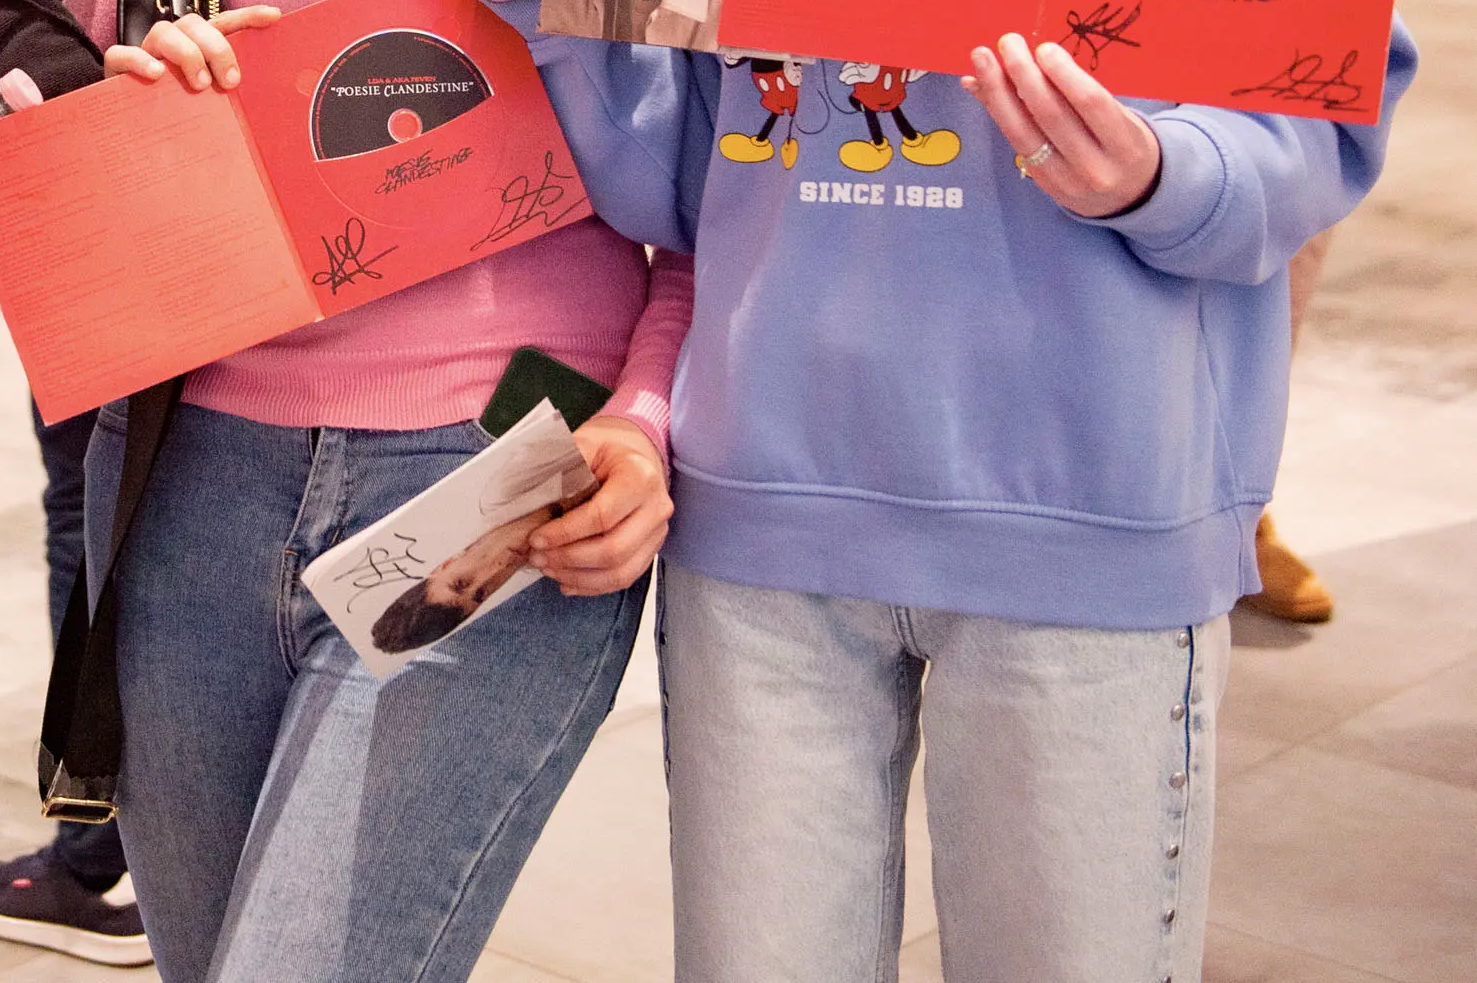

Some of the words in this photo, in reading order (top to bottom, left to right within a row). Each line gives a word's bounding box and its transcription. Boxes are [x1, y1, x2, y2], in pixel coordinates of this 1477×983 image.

[330, 86, 381, 97] "POESIE
[383, 82, 474, 97] CLANDESTINE"
[799, 181, 885, 206] SINCE
[894, 185, 964, 209] 1928
